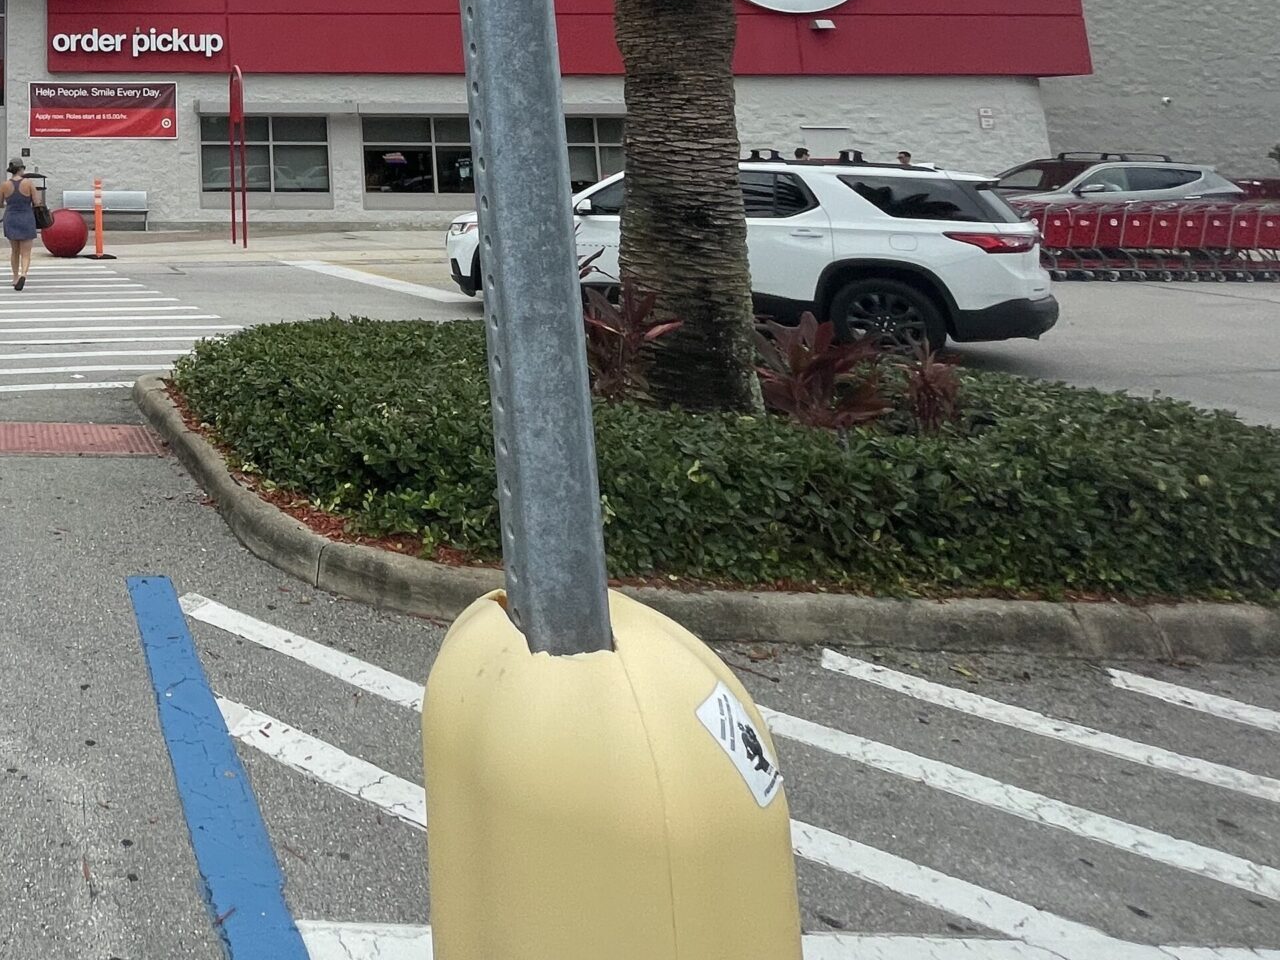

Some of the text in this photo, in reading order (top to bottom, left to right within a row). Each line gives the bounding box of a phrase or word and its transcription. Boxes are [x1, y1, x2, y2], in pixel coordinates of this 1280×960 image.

[52, 27, 224, 57] order pickup
[35, 87, 162, 98] Help People. Smile Every Day.
[35, 113, 51, 121] Apply
